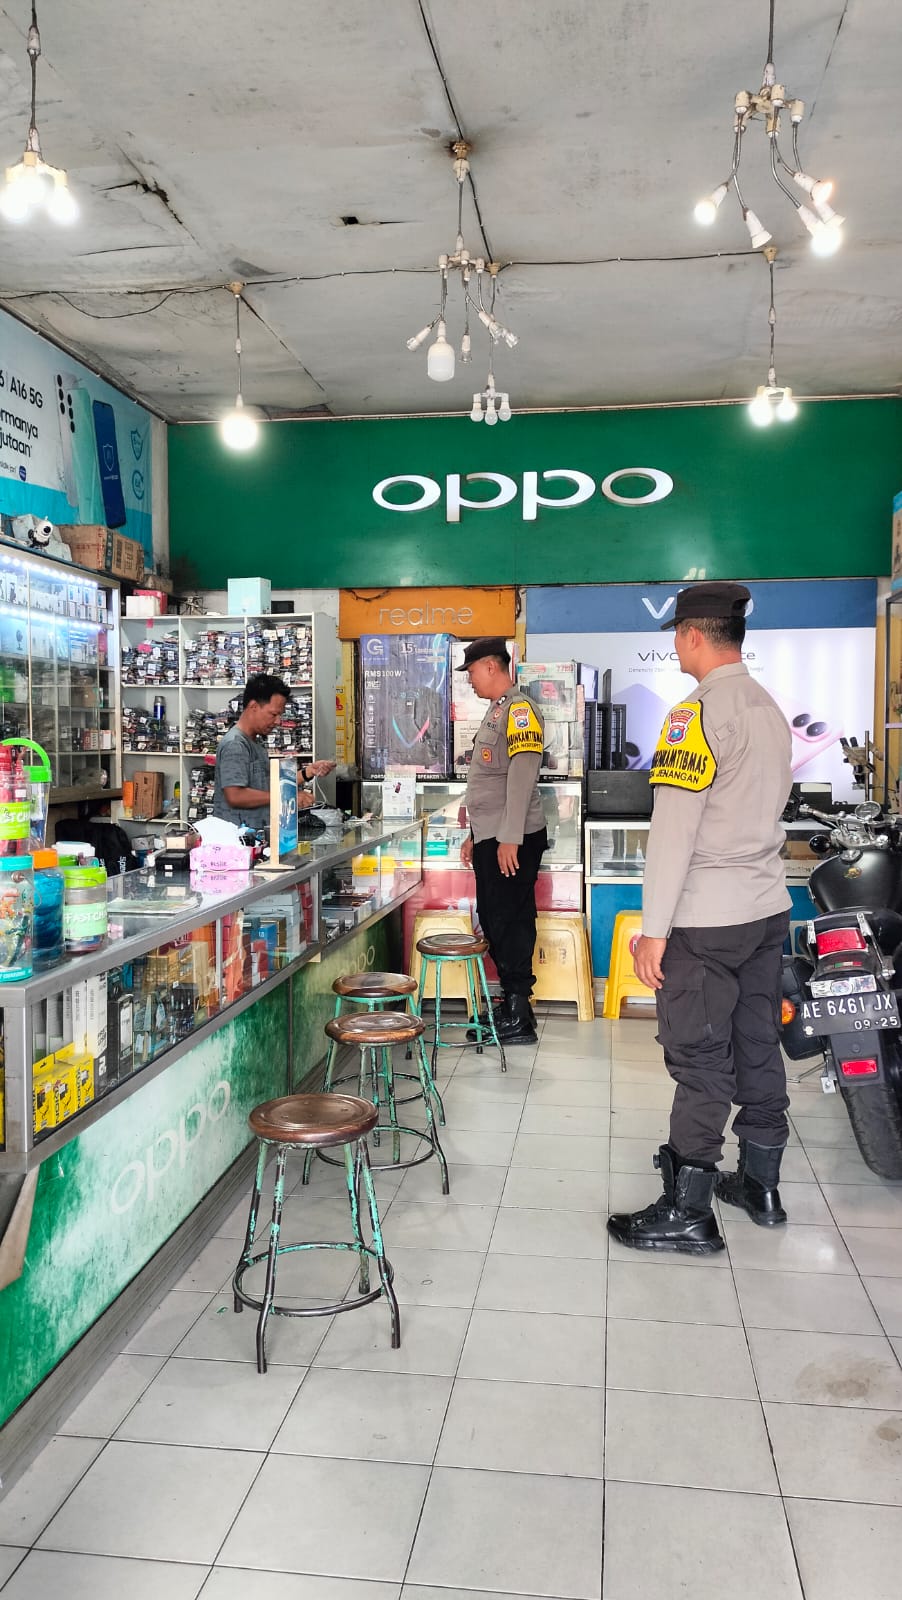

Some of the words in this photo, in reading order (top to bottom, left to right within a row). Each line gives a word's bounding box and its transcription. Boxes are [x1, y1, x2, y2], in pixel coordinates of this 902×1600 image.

[10, 376, 27, 400] A16
[30, 387, 43, 409] 5G
[372, 467, 674, 523] oppo
[378, 600, 473, 626] realme
[656, 769, 700, 784] JENANGAN
[803, 1003, 821, 1018] AE
[828, 998, 864, 1015] 6461
[874, 995, 892, 1010] JX
[111, 1080, 231, 1216] oppo
